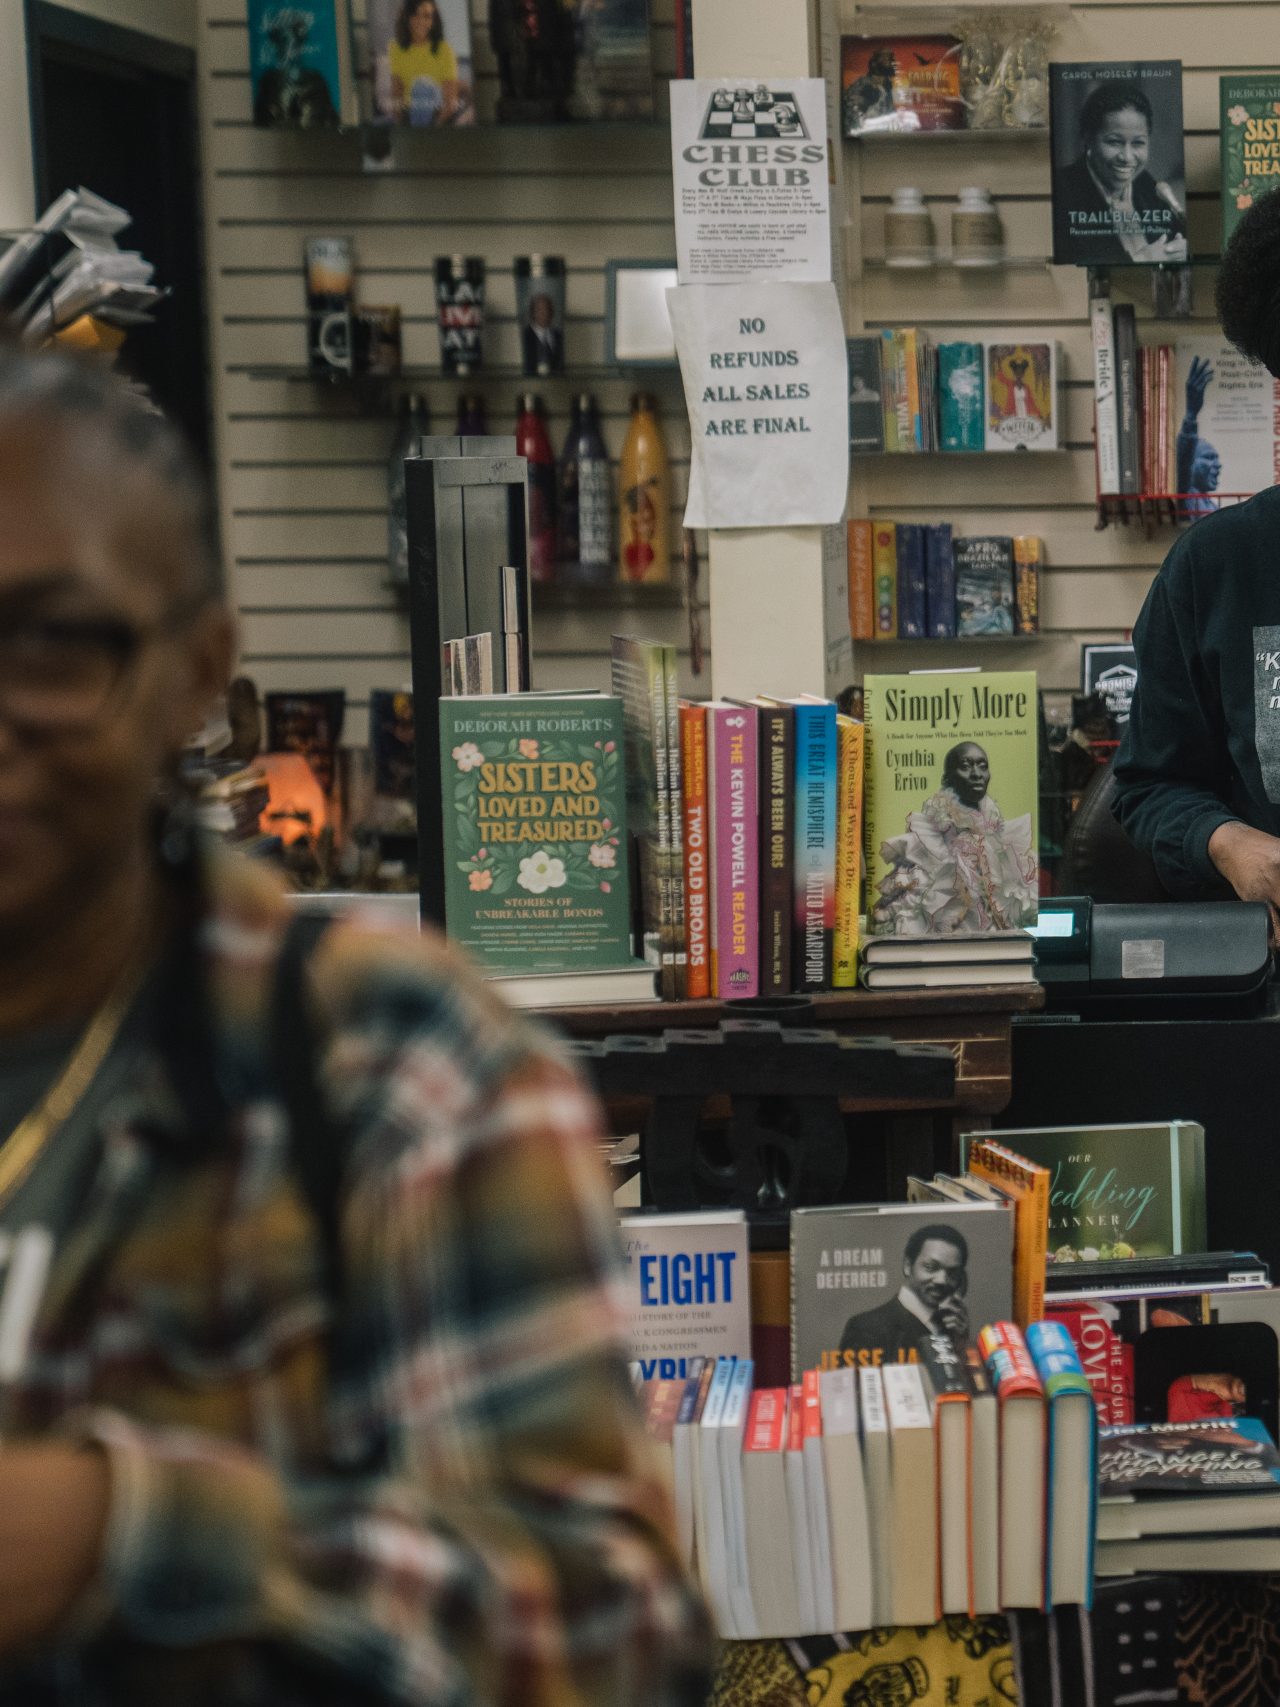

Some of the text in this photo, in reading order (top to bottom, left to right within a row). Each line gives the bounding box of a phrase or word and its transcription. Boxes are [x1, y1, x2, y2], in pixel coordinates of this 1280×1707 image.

[1061, 69, 1172, 81] CAROL MOSELEY BRAUN
[682, 145, 824, 164] CHESS
[698, 167, 811, 187] CLUB
[1068, 209, 1172, 225] TRAILBLAZER
[739, 317, 766, 335] NO
[709, 349, 799, 370] REFUNDS
[702, 382, 811, 403] ALL SALES
[704, 415, 811, 437] ARE FINAL
[885, 685, 1027, 729] Simply More
[453, 718, 613, 733] DEBORAH ROBERTS
[886, 748, 936, 772] Cynthia
[478, 760, 598, 795] SISTERS
[806, 715, 826, 850] THIS GREAT HEMISPHERE
[894, 773, 928, 792] Erivo
[771, 718, 784, 869] IT'S ALWAYS BEEN OURS
[477, 795, 601, 818] LOVED AND
[846, 734, 857, 889] A Thousand Ways to Die
[476, 820, 606, 843] TREASURED
[730, 735, 746, 955] THE KEVIN POWELL READER
[688, 806, 705, 967] TWO OLD BROADS
[475, 906, 604, 920] UNBREAKABLE BONDS
[503, 897, 574, 908] STORIES OF
[805, 912, 825, 983] ASKARIPOUR
[1067, 1153, 1092, 1164] OUR
[820, 1247, 884, 1266] A DREAM
[639, 1251, 737, 1307] EIGHT
[816, 1270, 888, 1290] DEFERRED
[651, 1325, 727, 1337] CONGRESSMEN
[816, 1348, 884, 1370] JESSE
[1080, 1313, 1107, 1388] LOVE
[1111, 1334, 1122, 1366] THE
